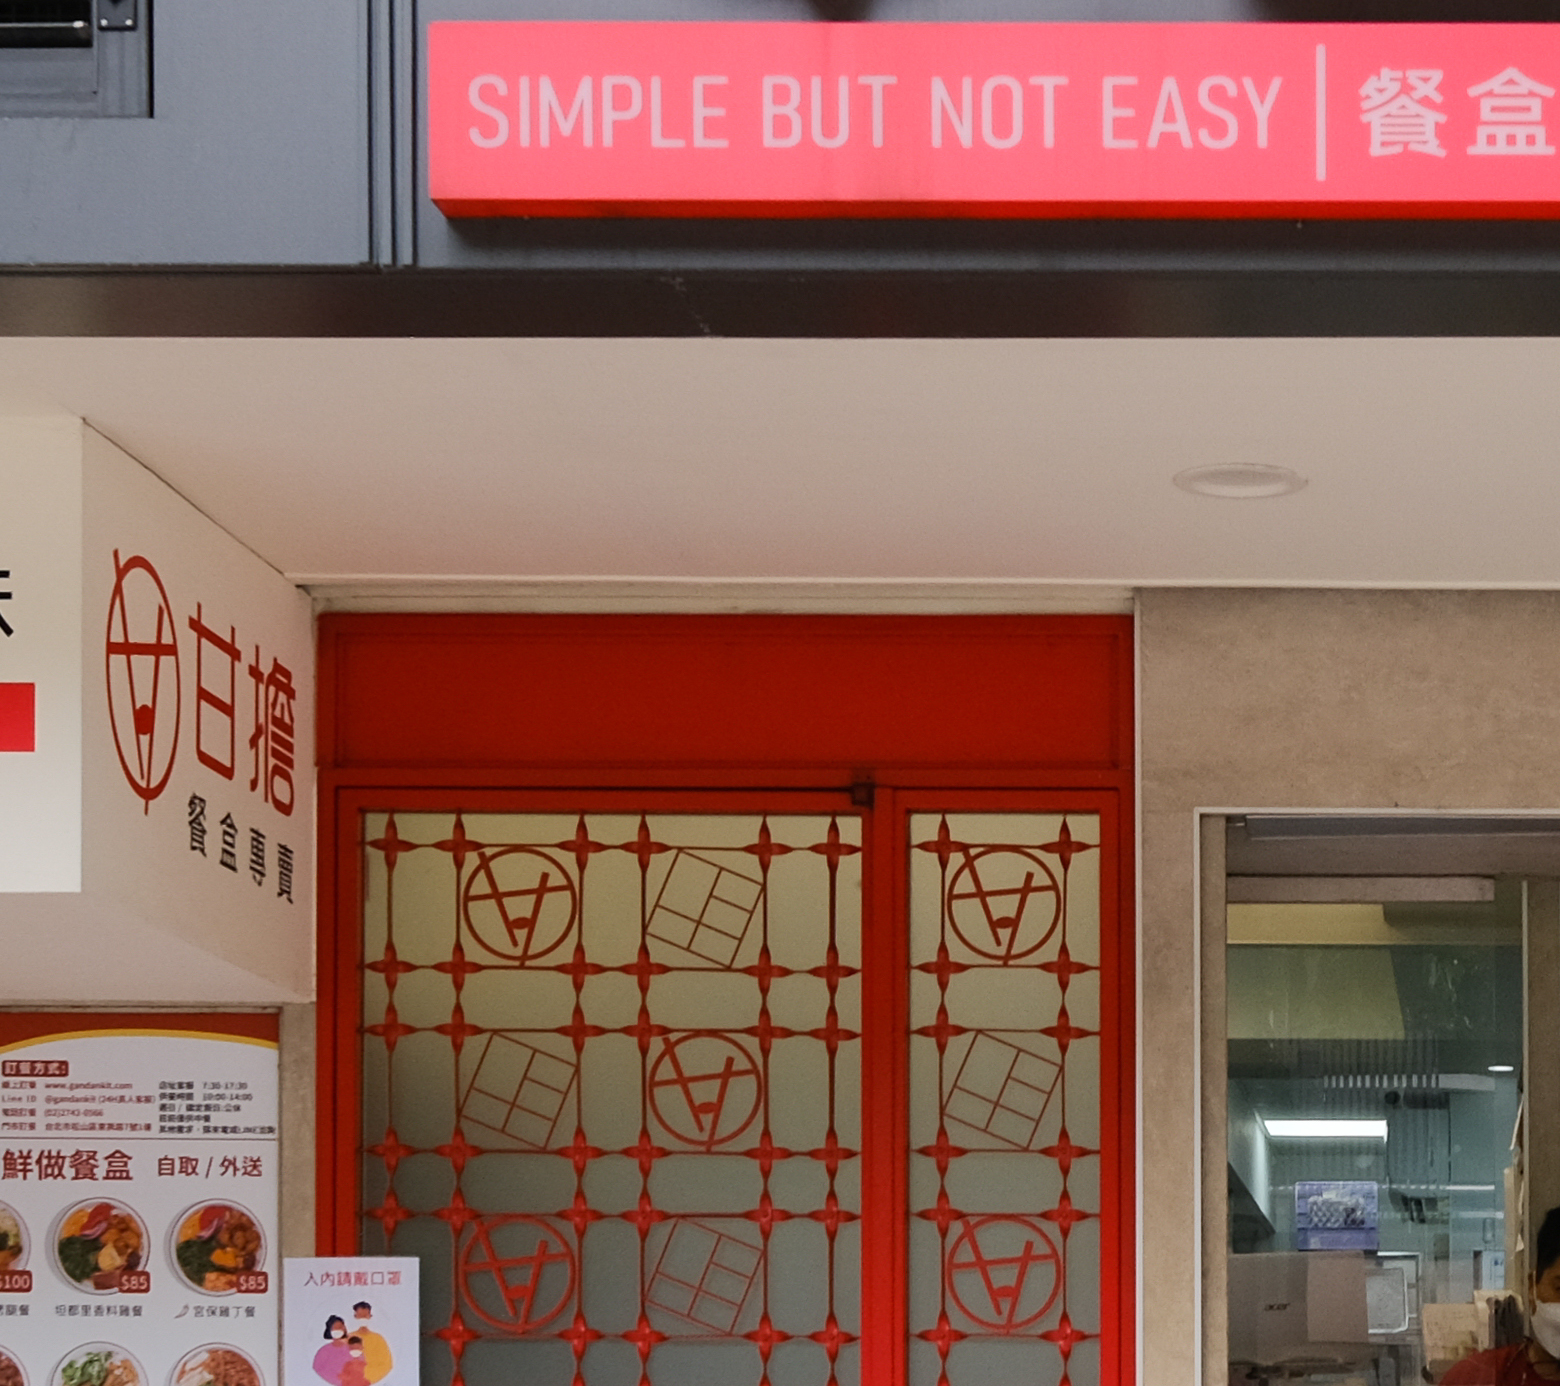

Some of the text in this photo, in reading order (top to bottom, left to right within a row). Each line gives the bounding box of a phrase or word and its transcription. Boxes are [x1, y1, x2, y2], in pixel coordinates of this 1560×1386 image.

[467, 72, 729, 152] SIMPLE
[761, 72, 897, 152] BUT
[929, 72, 1069, 152] NOT
[1100, 72, 1282, 152] EASY
[188, 601, 297, 818] 甘擔
[1, 1094, 25, 1104] Line
[28, 1095, 37, 1104] ID
[0, 1148, 134, 1182] 鮮做餐盒
[157, 1155, 199, 1178] 自取
[218, 1155, 264, 1179] 外送
[120, 1273, 149, 1291] $85
[238, 1273, 267, 1292] $85
[303, 1270, 403, 1287] 入內請戴口罩
